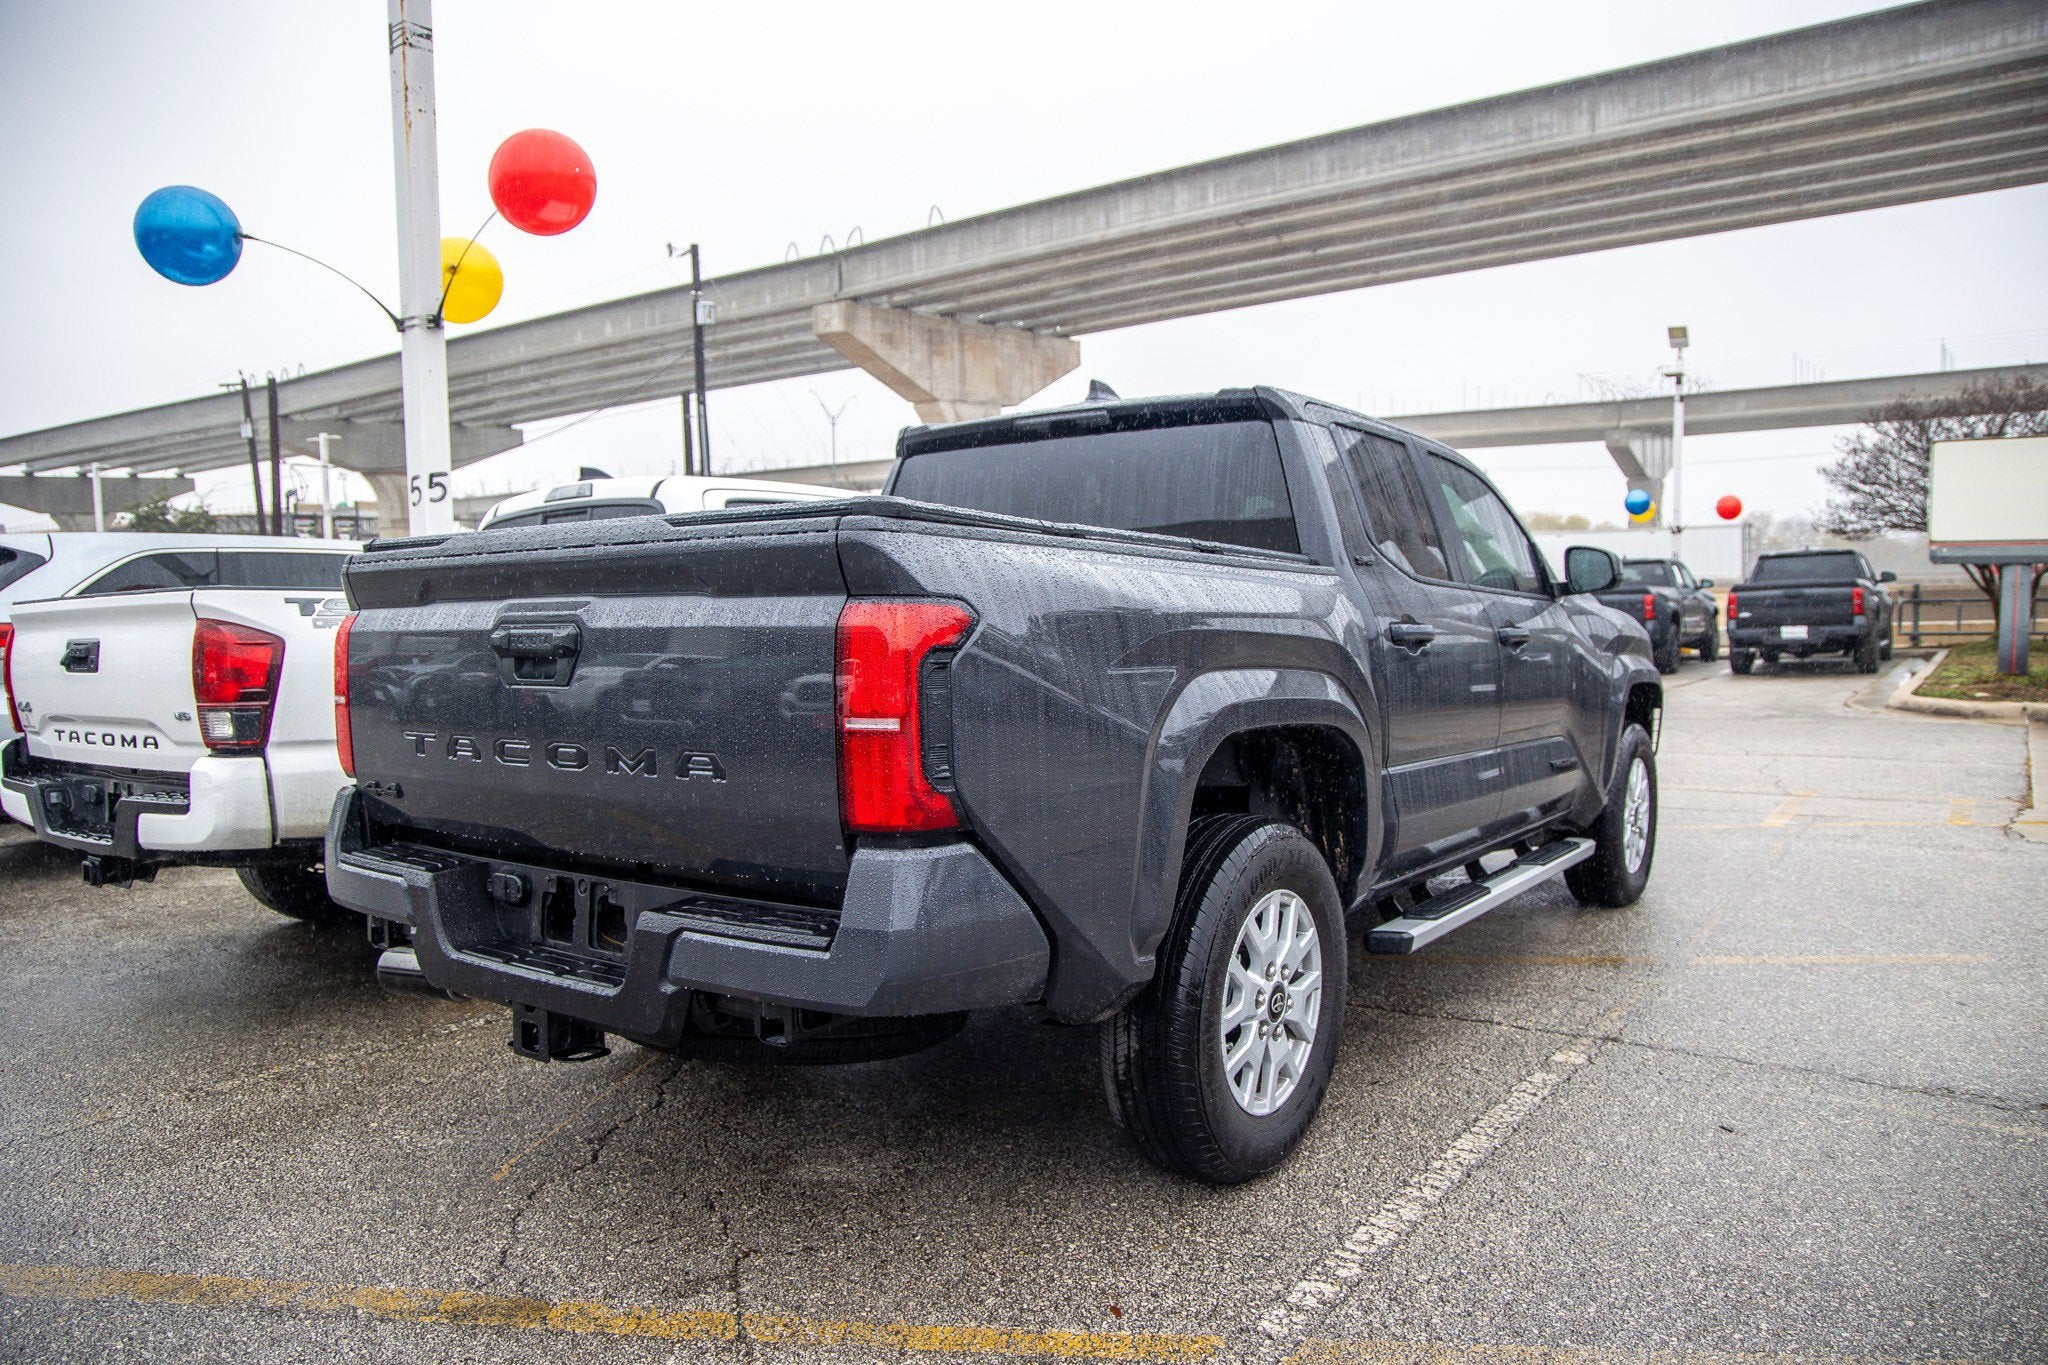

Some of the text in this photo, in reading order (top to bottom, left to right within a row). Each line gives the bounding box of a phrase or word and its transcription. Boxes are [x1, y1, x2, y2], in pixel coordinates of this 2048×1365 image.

[411, 471, 448, 506] 55
[54, 729, 159, 749] TACOMA
[404, 731, 727, 783] TACOMA
